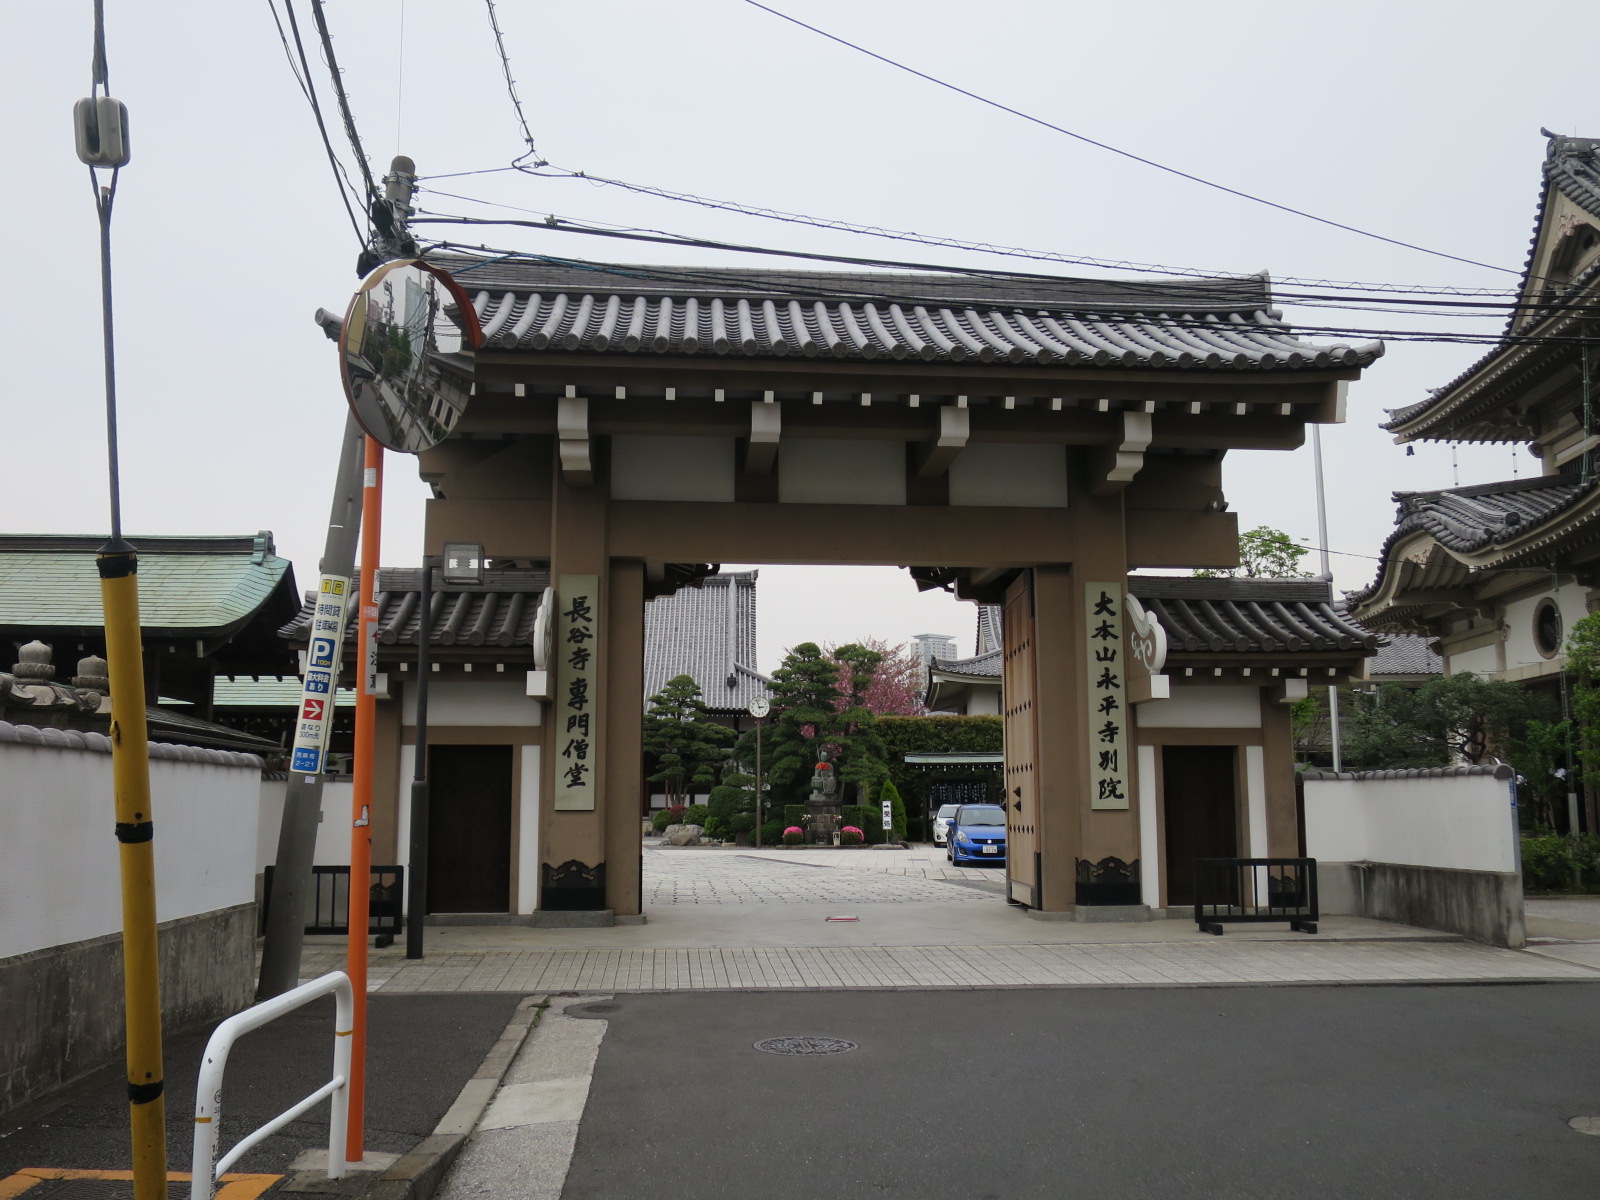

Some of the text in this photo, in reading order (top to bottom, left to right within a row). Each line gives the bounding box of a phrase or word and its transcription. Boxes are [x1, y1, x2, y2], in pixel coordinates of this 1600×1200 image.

[317, 603, 342, 617] 時間貸
[312, 641, 331, 664] P
[307, 672, 330, 683] 最大料金
[308, 682, 324, 692] あり
[1090, 591, 1125, 800] 大本山永平寺別院
[295, 760, 314, 768] 2-21
